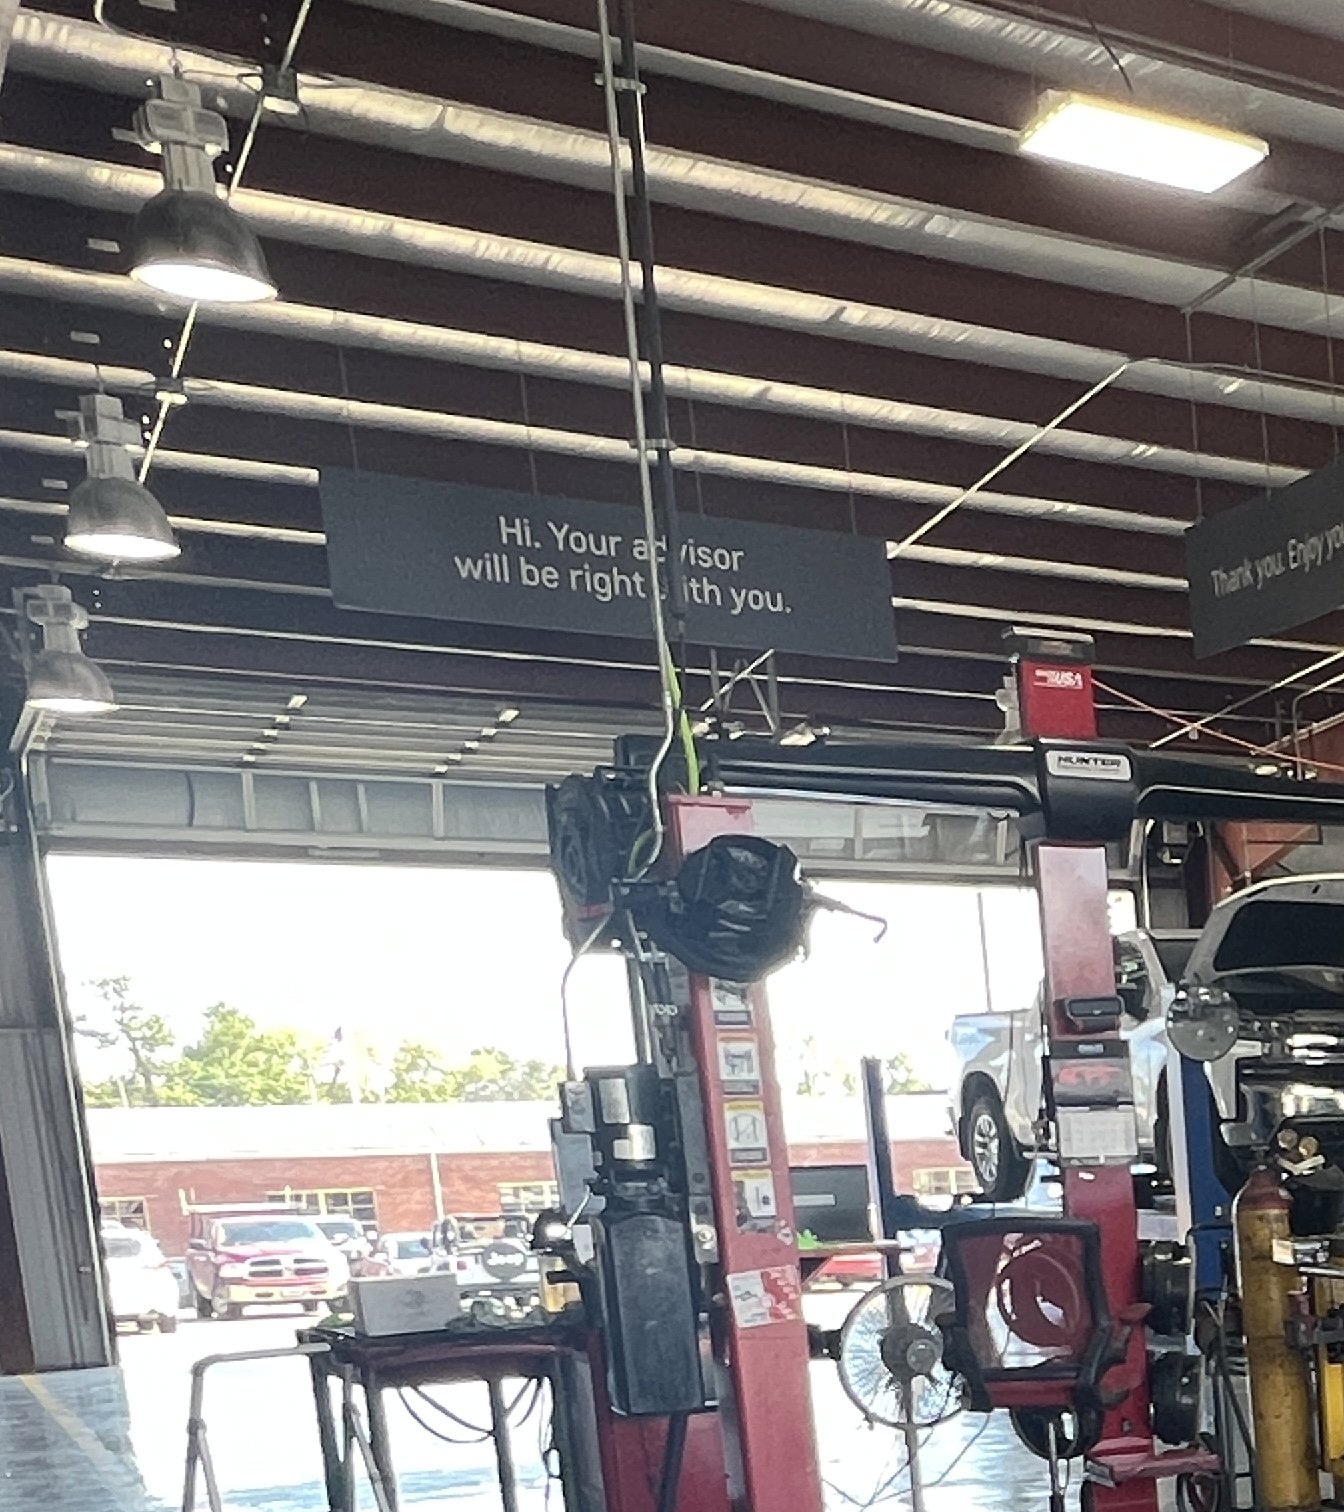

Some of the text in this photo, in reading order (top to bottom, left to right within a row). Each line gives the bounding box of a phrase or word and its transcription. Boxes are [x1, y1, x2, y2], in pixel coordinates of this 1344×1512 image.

[499, 516, 542, 549] Hi.
[547, 521, 622, 557] Your
[1211, 557, 1254, 597] Thank
[1255, 552, 1286, 590] you.
[1287, 536, 1324, 574] Enjoy
[453, 552, 792, 615] will be right ith you.
